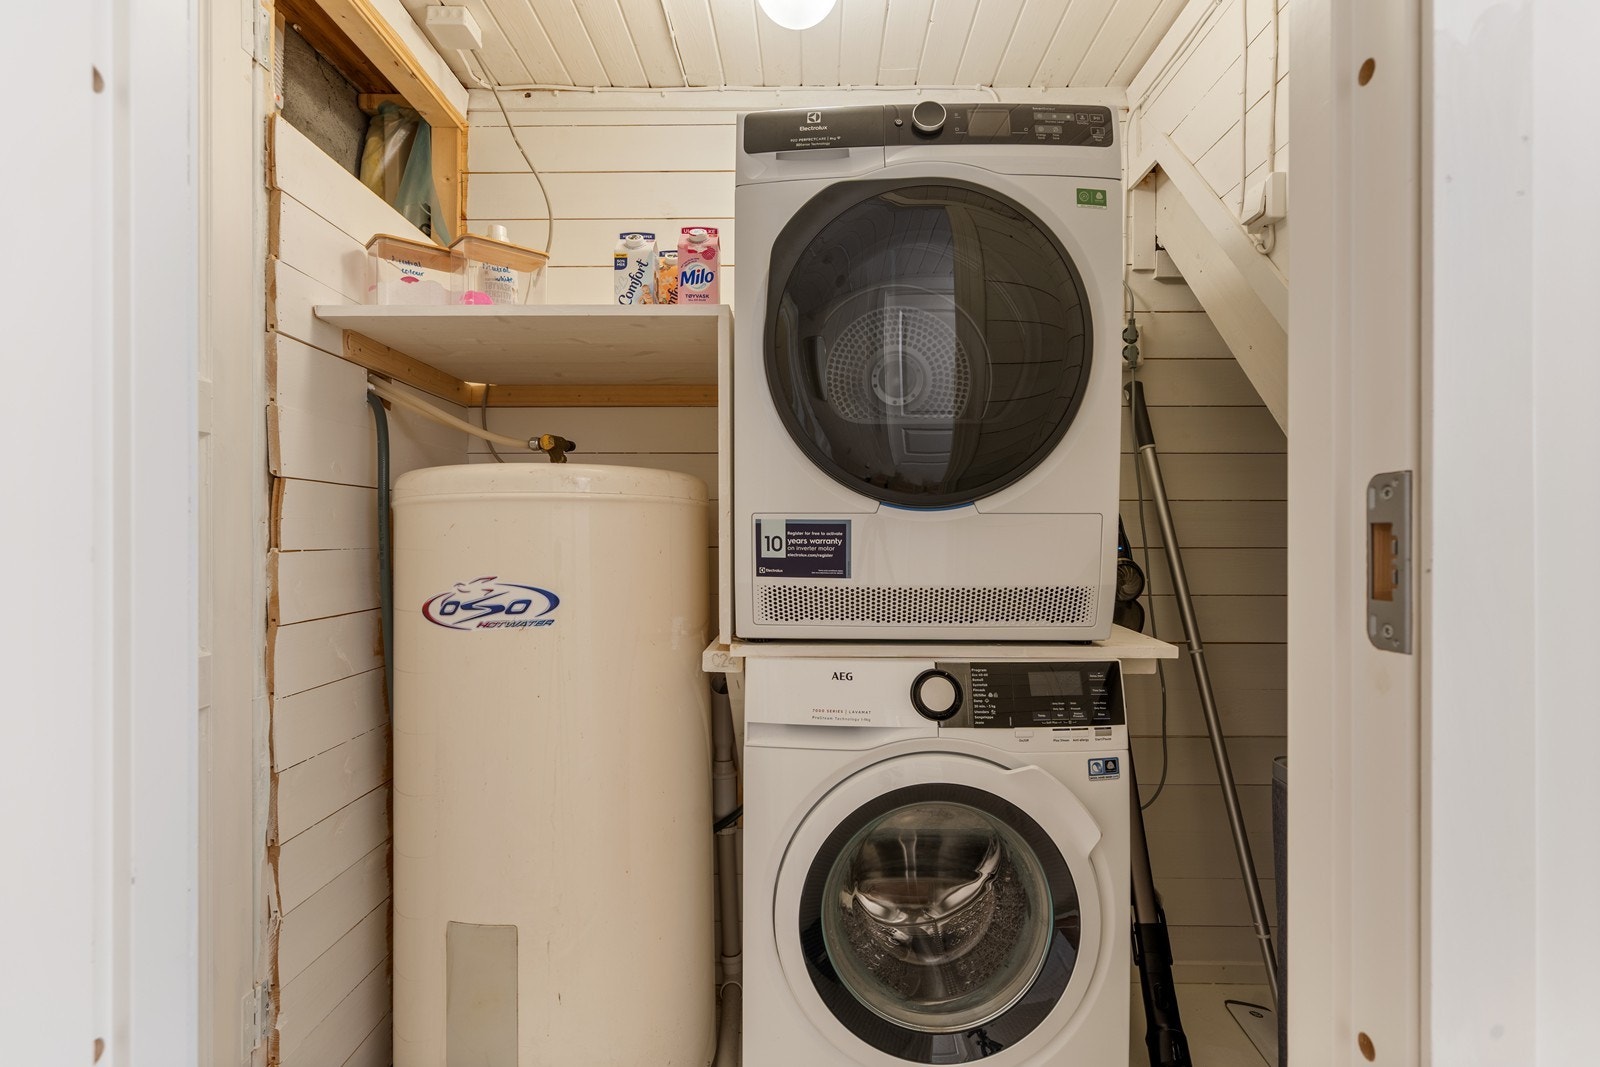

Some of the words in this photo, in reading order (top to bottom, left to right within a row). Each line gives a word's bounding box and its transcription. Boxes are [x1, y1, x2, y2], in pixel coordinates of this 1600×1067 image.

[618, 258, 649, 305] Comfort
[680, 268, 714, 287] Milo
[764, 535, 783, 552] 10
[809, 538, 843, 546] warranty
[476, 619, 555, 629] HOTWATER
[831, 671, 853, 681] AEG
